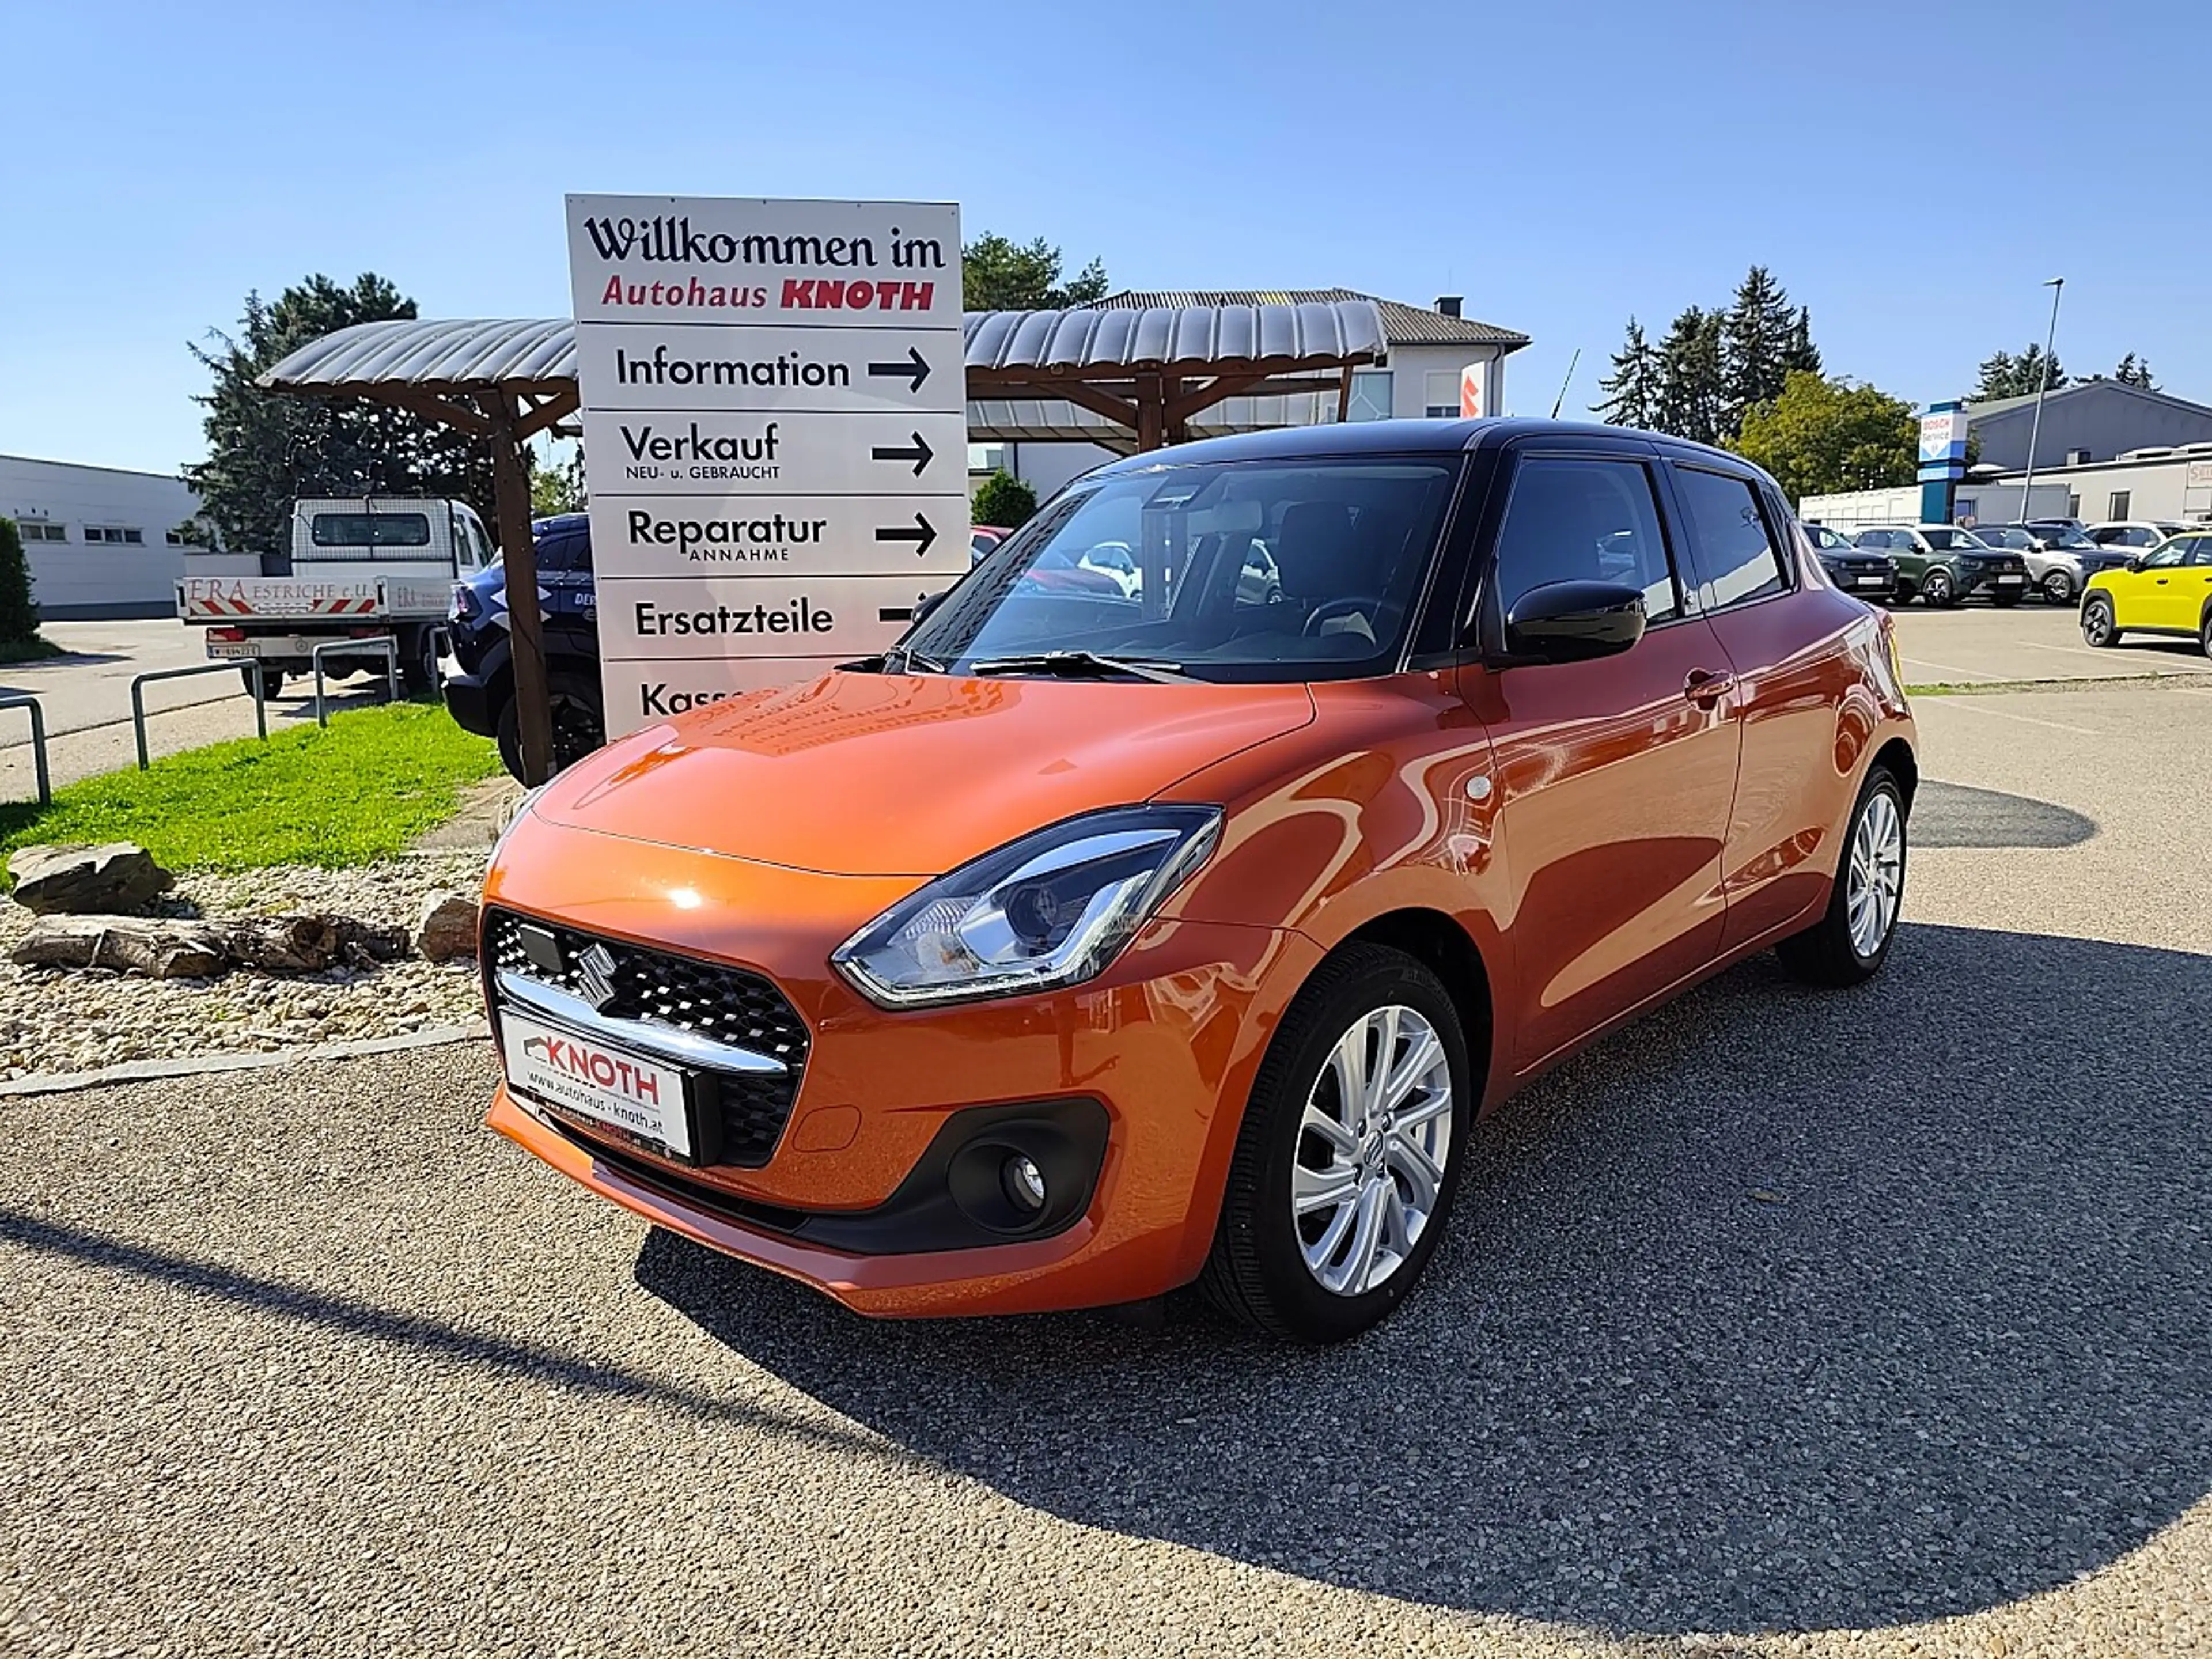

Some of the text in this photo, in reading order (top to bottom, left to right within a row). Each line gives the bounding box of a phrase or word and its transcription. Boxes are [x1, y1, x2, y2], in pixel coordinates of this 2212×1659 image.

[583, 214, 947, 269] Willkommen im
[601, 274, 934, 310] Autohaus KNOTH
[616, 344, 850, 387] Information
[619, 422, 780, 462] Verkauf
[626, 465, 781, 480] NEU- u. GEBRAUCHT
[628, 510, 828, 554] Reparatur
[688, 547, 790, 563] ANNAHME
[188, 578, 247, 600] ERA
[253, 584, 335, 599] ESTRICHE
[635, 596, 834, 636] Ersatzteile
[546, 1036, 660, 1107] KNOTH
